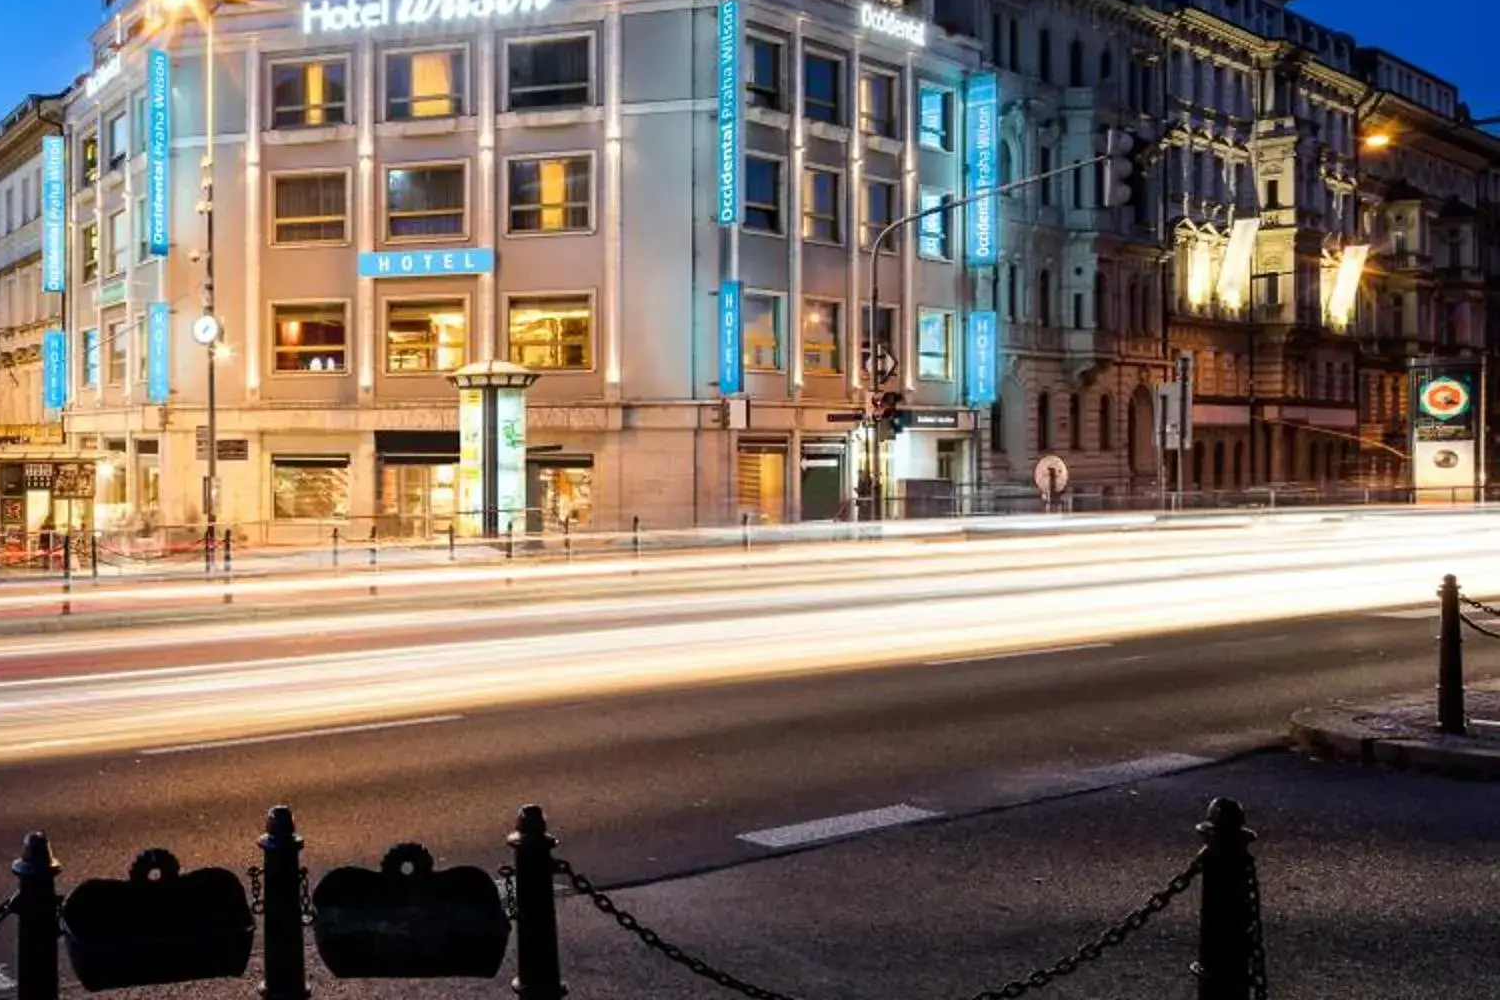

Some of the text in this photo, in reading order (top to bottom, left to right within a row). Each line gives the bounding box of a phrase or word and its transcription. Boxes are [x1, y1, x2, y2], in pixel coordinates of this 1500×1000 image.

[153, 56, 165, 109] Wilson
[721, 1, 733, 222] Occidental Praha Wilson
[154, 112, 165, 156] Praha
[378, 252, 476, 272] HOTEL
[725, 293, 733, 382] HOTEL
[976, 319, 987, 393] HOTEL
[50, 340, 60, 401] HOTEL
